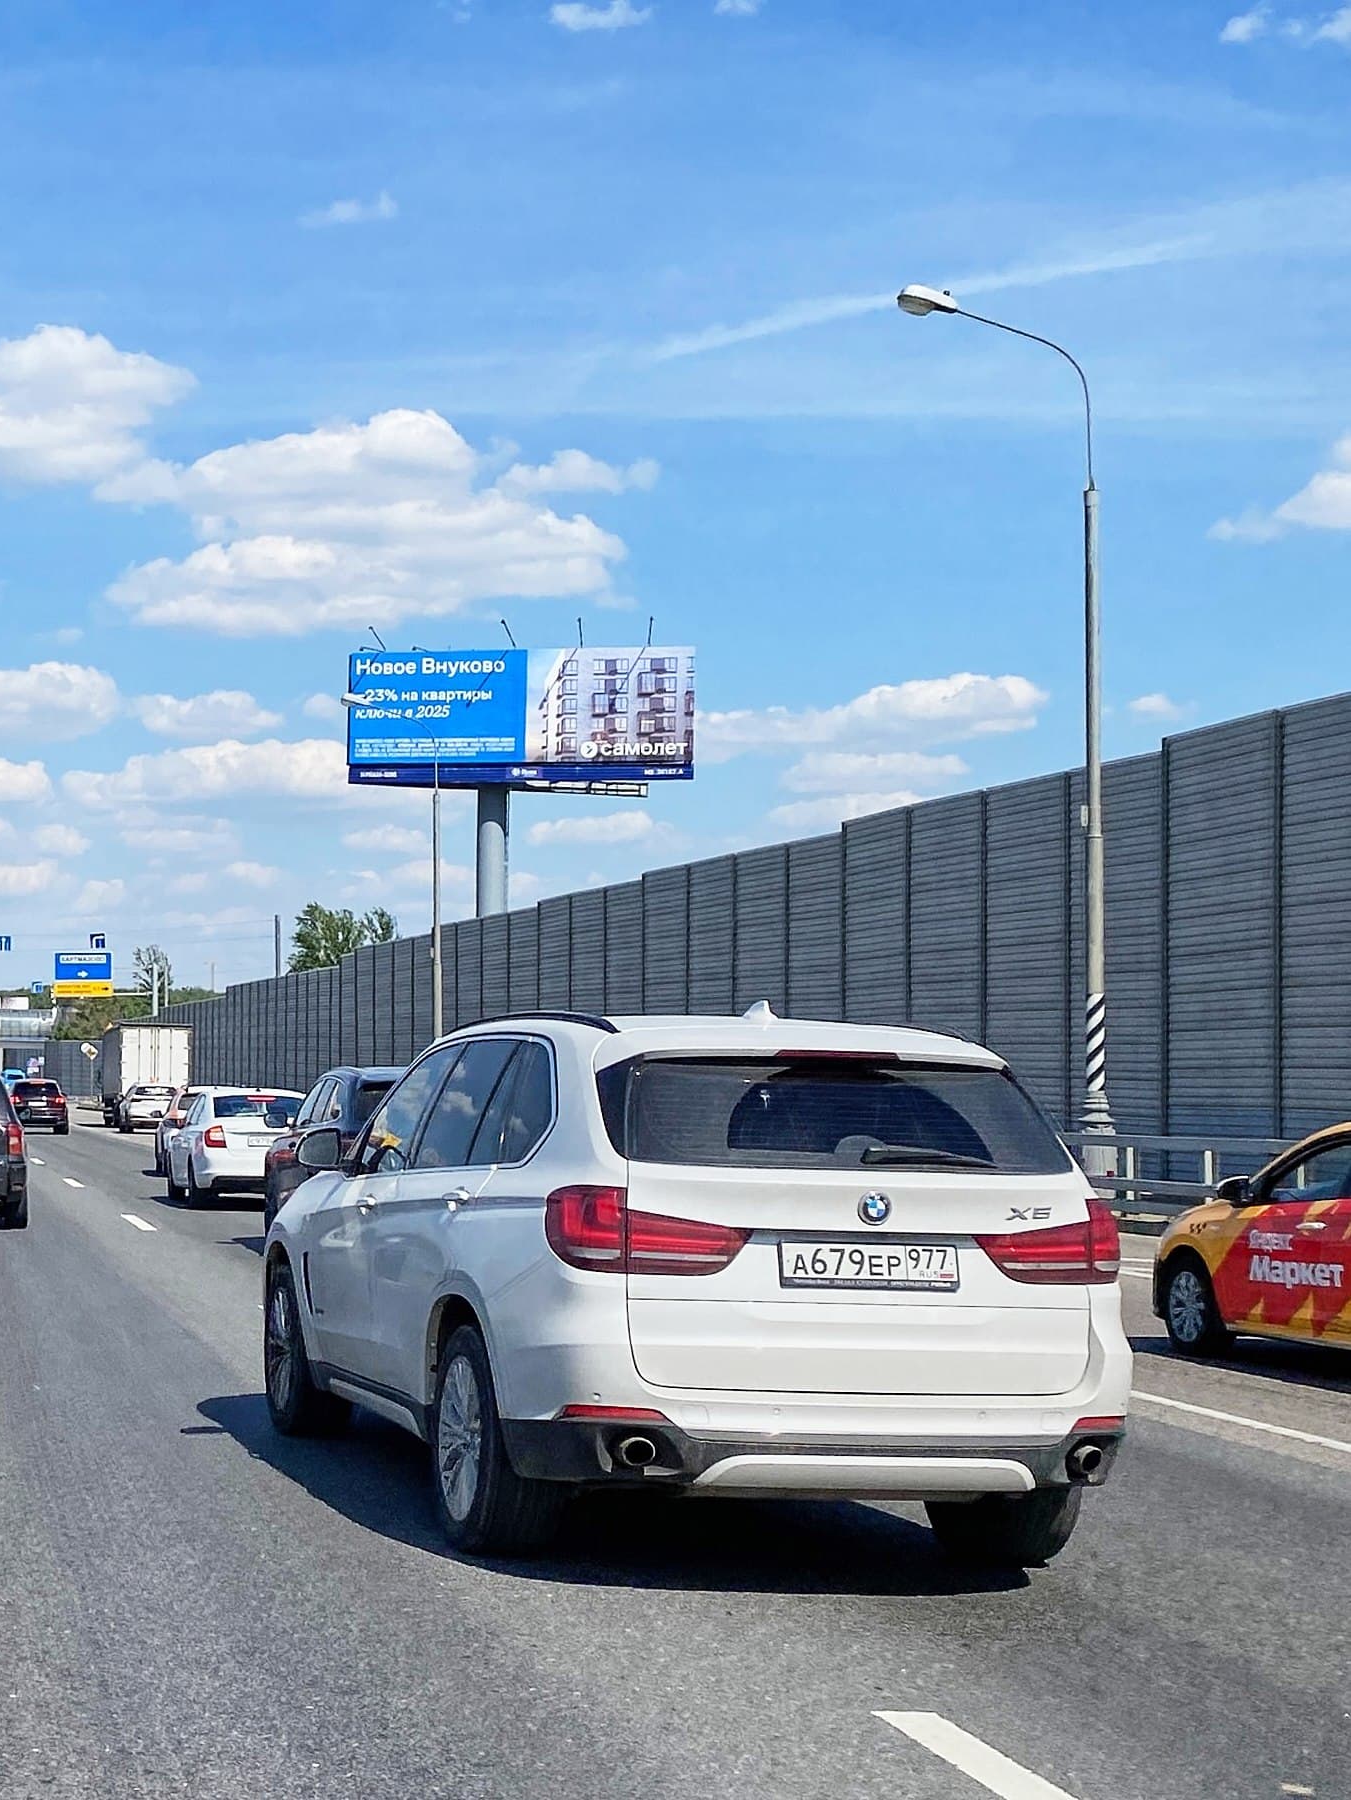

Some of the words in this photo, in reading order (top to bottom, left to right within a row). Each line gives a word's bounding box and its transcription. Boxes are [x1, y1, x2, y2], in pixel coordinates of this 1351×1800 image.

[356, 658, 416, 675] Новое
[422, 657, 505, 677] Внуково
[402, 691, 419, 701] на
[422, 689, 492, 703] квартиры
[355, 707, 403, 719] ключи
[405, 707, 414, 718] в
[415, 705, 451, 718] 2025
[601, 742, 688, 756] самолет
[1250, 1255, 1344, 1289] Маркет
